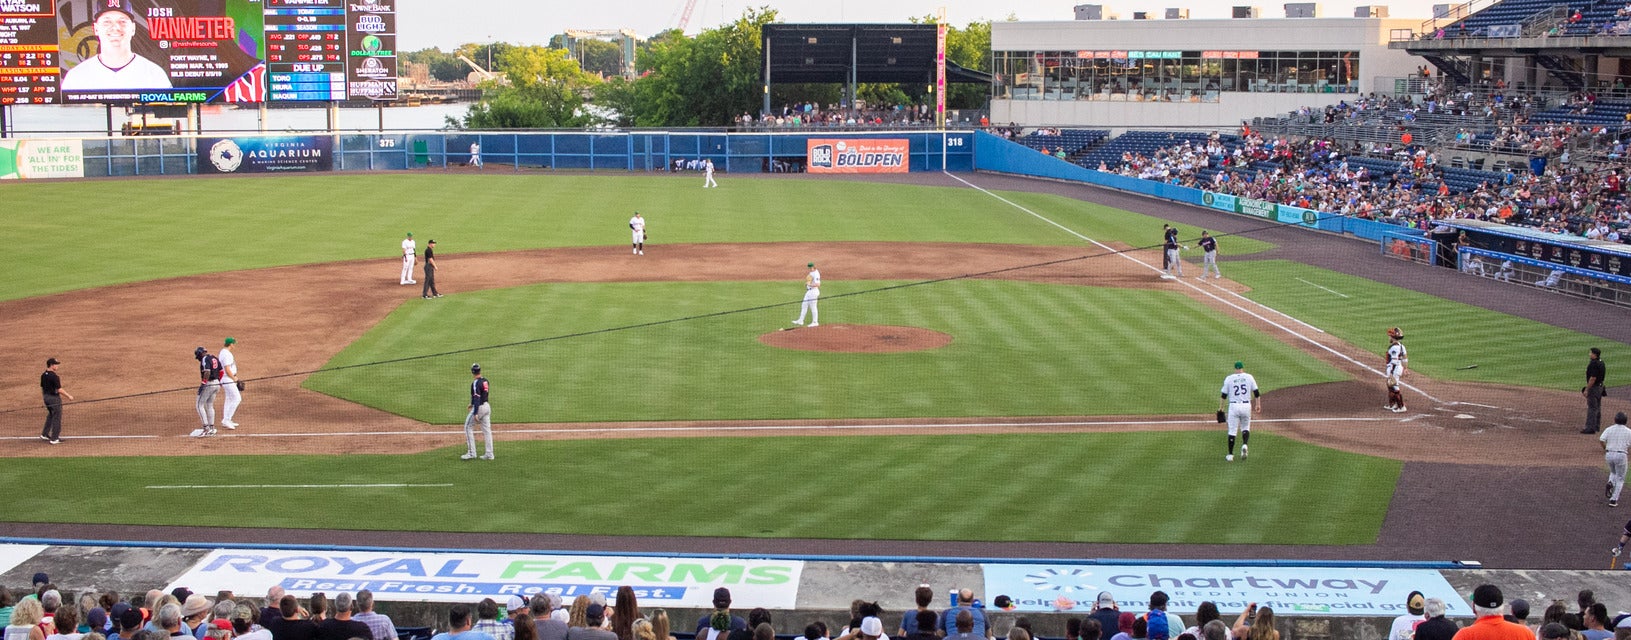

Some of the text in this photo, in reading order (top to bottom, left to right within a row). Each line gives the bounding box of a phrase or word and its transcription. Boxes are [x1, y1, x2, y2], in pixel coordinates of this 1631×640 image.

[148, 8, 172, 16] JOSH
[147, 17, 235, 39] VANMETER
[380, 139, 394, 148] 375
[948, 138, 962, 146] 318
[249, 149, 321, 158] AQUARIUM
[837, 153, 902, 166] BOLDPEN
[1233, 384, 1247, 396] 25
[201, 554, 792, 585] ROYAL FARMS
[291, 580, 370, 590] Real
[378, 581, 482, 594] Fresh.
[497, 584, 576, 596] Real
[1108, 574, 1388, 594] Chartway
